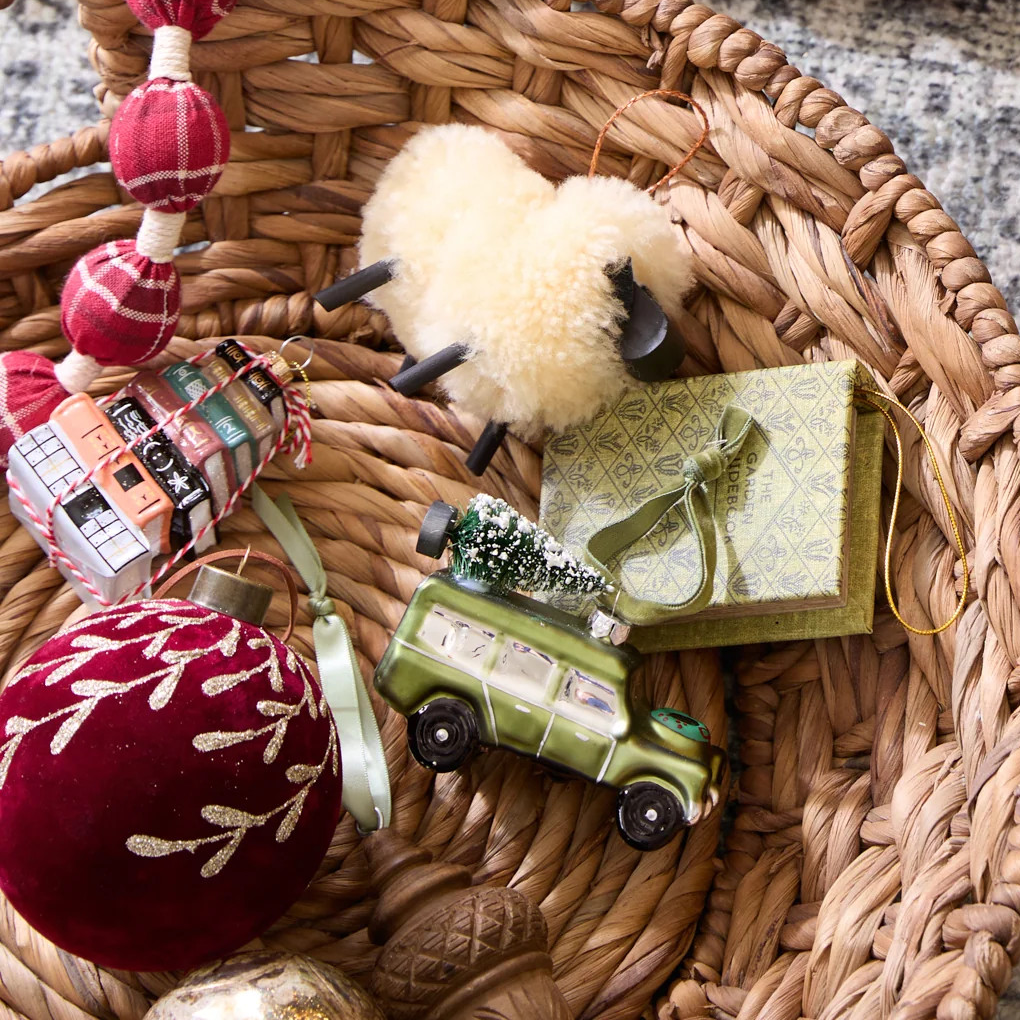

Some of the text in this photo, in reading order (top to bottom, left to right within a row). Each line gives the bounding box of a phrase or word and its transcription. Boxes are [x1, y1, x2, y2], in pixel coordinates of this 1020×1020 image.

[724, 451, 741, 544] IDEBOOK
[742, 452, 758, 525] GARDEN
[761, 469, 774, 503] THE
